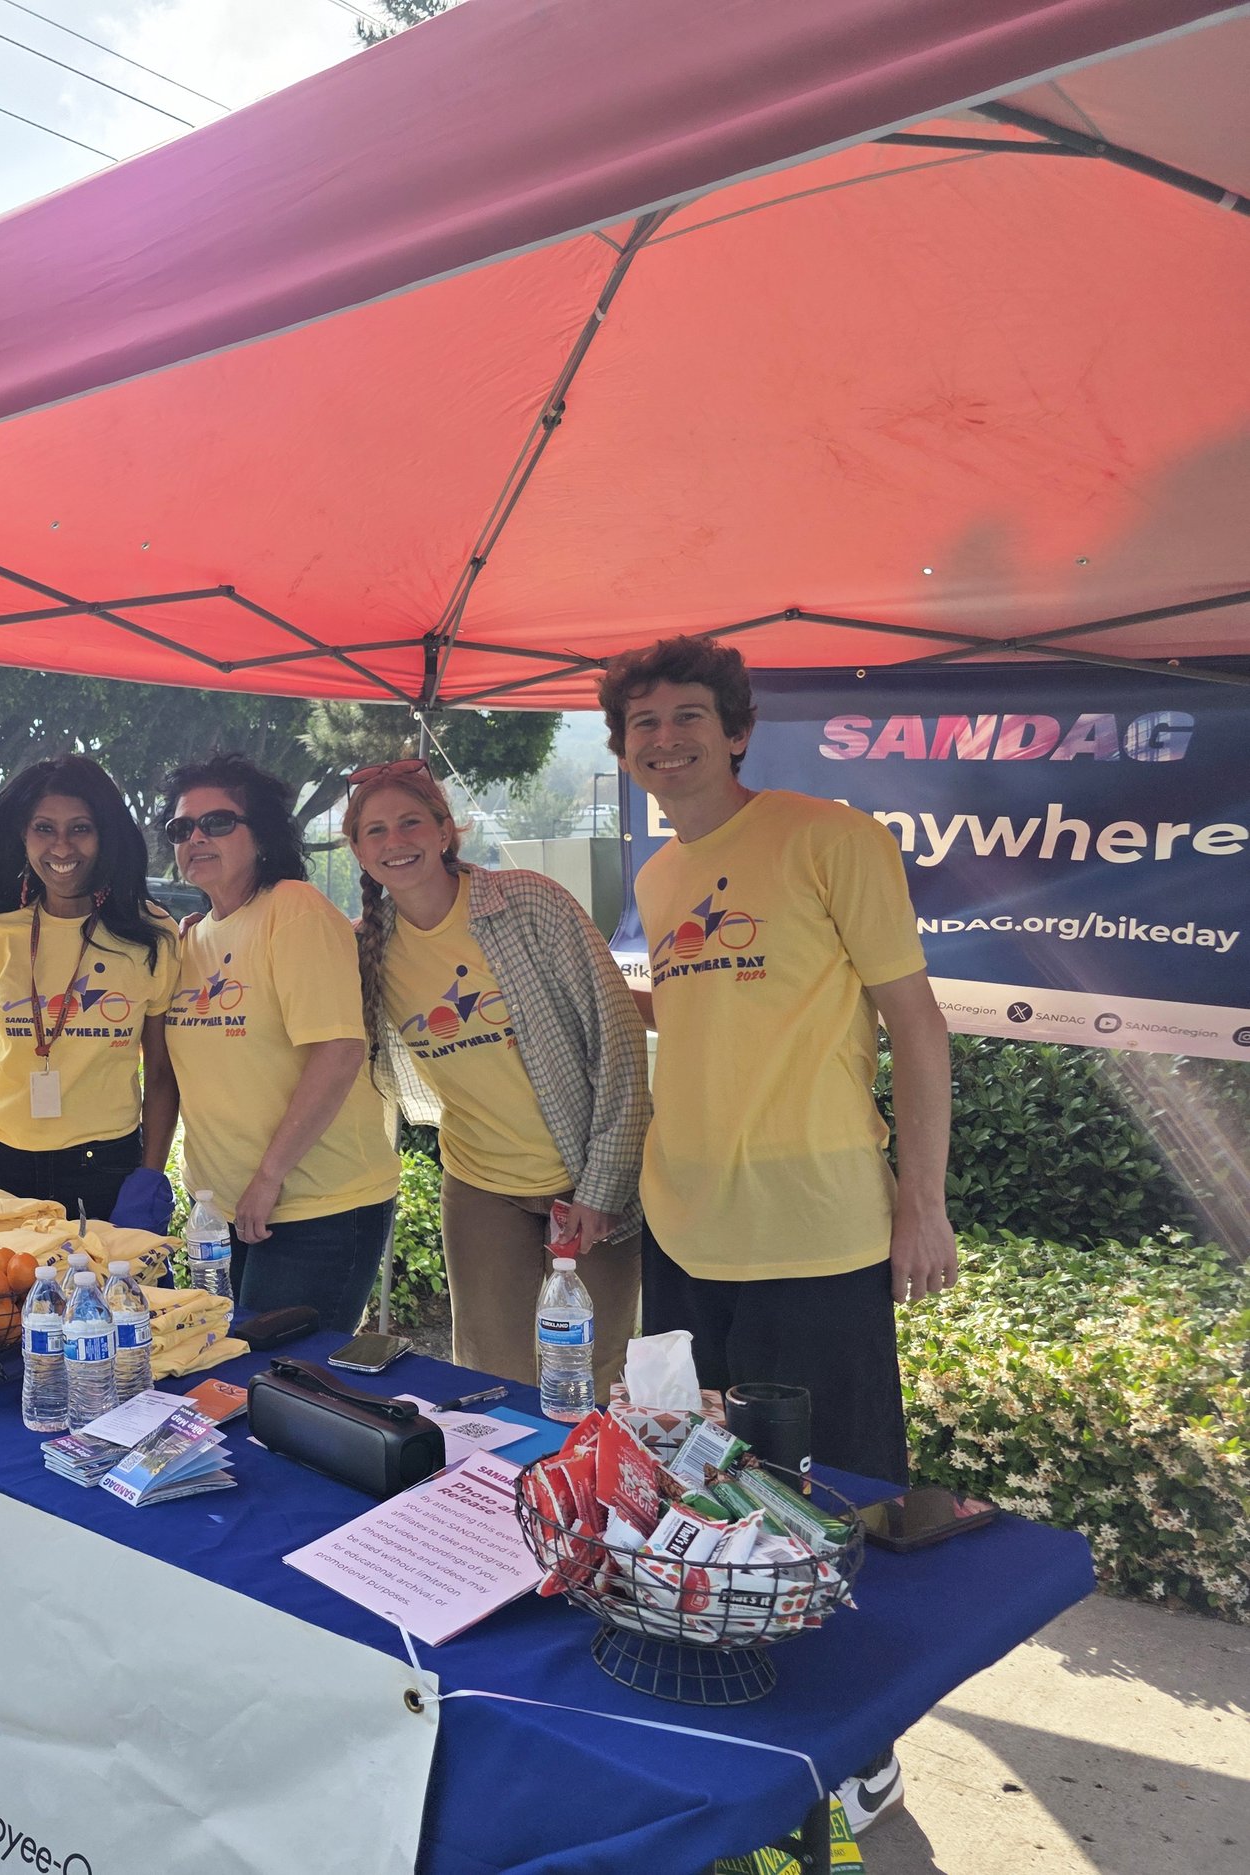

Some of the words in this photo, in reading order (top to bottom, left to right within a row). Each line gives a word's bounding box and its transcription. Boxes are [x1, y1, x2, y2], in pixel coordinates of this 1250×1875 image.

[818, 710, 1195, 762] SANDAG
[834, 799, 1250, 867] nywhere
[916, 912, 1241, 953] NDAG.org/bikeday
[621, 963, 652, 979] Bik
[737, 956, 765, 968] DAY
[735, 970, 766, 981] 2026
[938, 1001, 997, 1015] DAGregion
[1035, 1012, 1086, 1025] SANDAG
[6, 1027, 32, 1037] BIKE
[43, 1027, 110, 1037] NWHERE
[114, 1027, 134, 1037] DAY
[224, 1016, 246, 1026] DAY
[225, 1028, 247, 1037] 2026
[1124, 1021, 1219, 1039] SANDAGregion
[432, 1032, 503, 1058] ANYWHERE
[170, 1414, 189, 1427] Map
[187, 1422, 207, 1435] Bike
[103, 1477, 136, 1501] SANDAG
[477, 1465, 517, 1489] SANDA
[437, 1487, 497, 1515] Release
[451, 1481, 498, 1506] Photo
[403, 1502, 423, 1514] you
[422, 1511, 448, 1525] allow
[446, 1523, 489, 1545] SANDAG
[487, 1542, 508, 1553] and
[507, 1550, 521, 1559] its
[420, 1495, 431, 1503] By
[432, 1499, 477, 1525] attending
[476, 1521, 495, 1533] this
[496, 1530, 524, 1546] event
[376, 1519, 395, 1530] and
[394, 1526, 419, 1542] video
[418, 1539, 468, 1566] recordings
[467, 1564, 481, 1572] of
[391, 1510, 428, 1531] affiliates
[428, 1528, 439, 1537] to
[439, 1533, 460, 1547] take
[458, 1545, 522, 1577] photographs
[313, 1551, 370, 1582] promotional
[331, 1542, 345, 1552] for
[435, 1598, 448, 1607] or
[346, 1534, 359, 1543] be
[358, 1540, 383, 1555] used
[380, 1552, 417, 1573] without
[415, 1570, 462, 1597] limitation
[417, 1555, 438, 1567] and
[436, 1563, 468, 1583] videos
[466, 1580, 491, 1594] may
[715, 1854, 753, 1875] ALLEY
